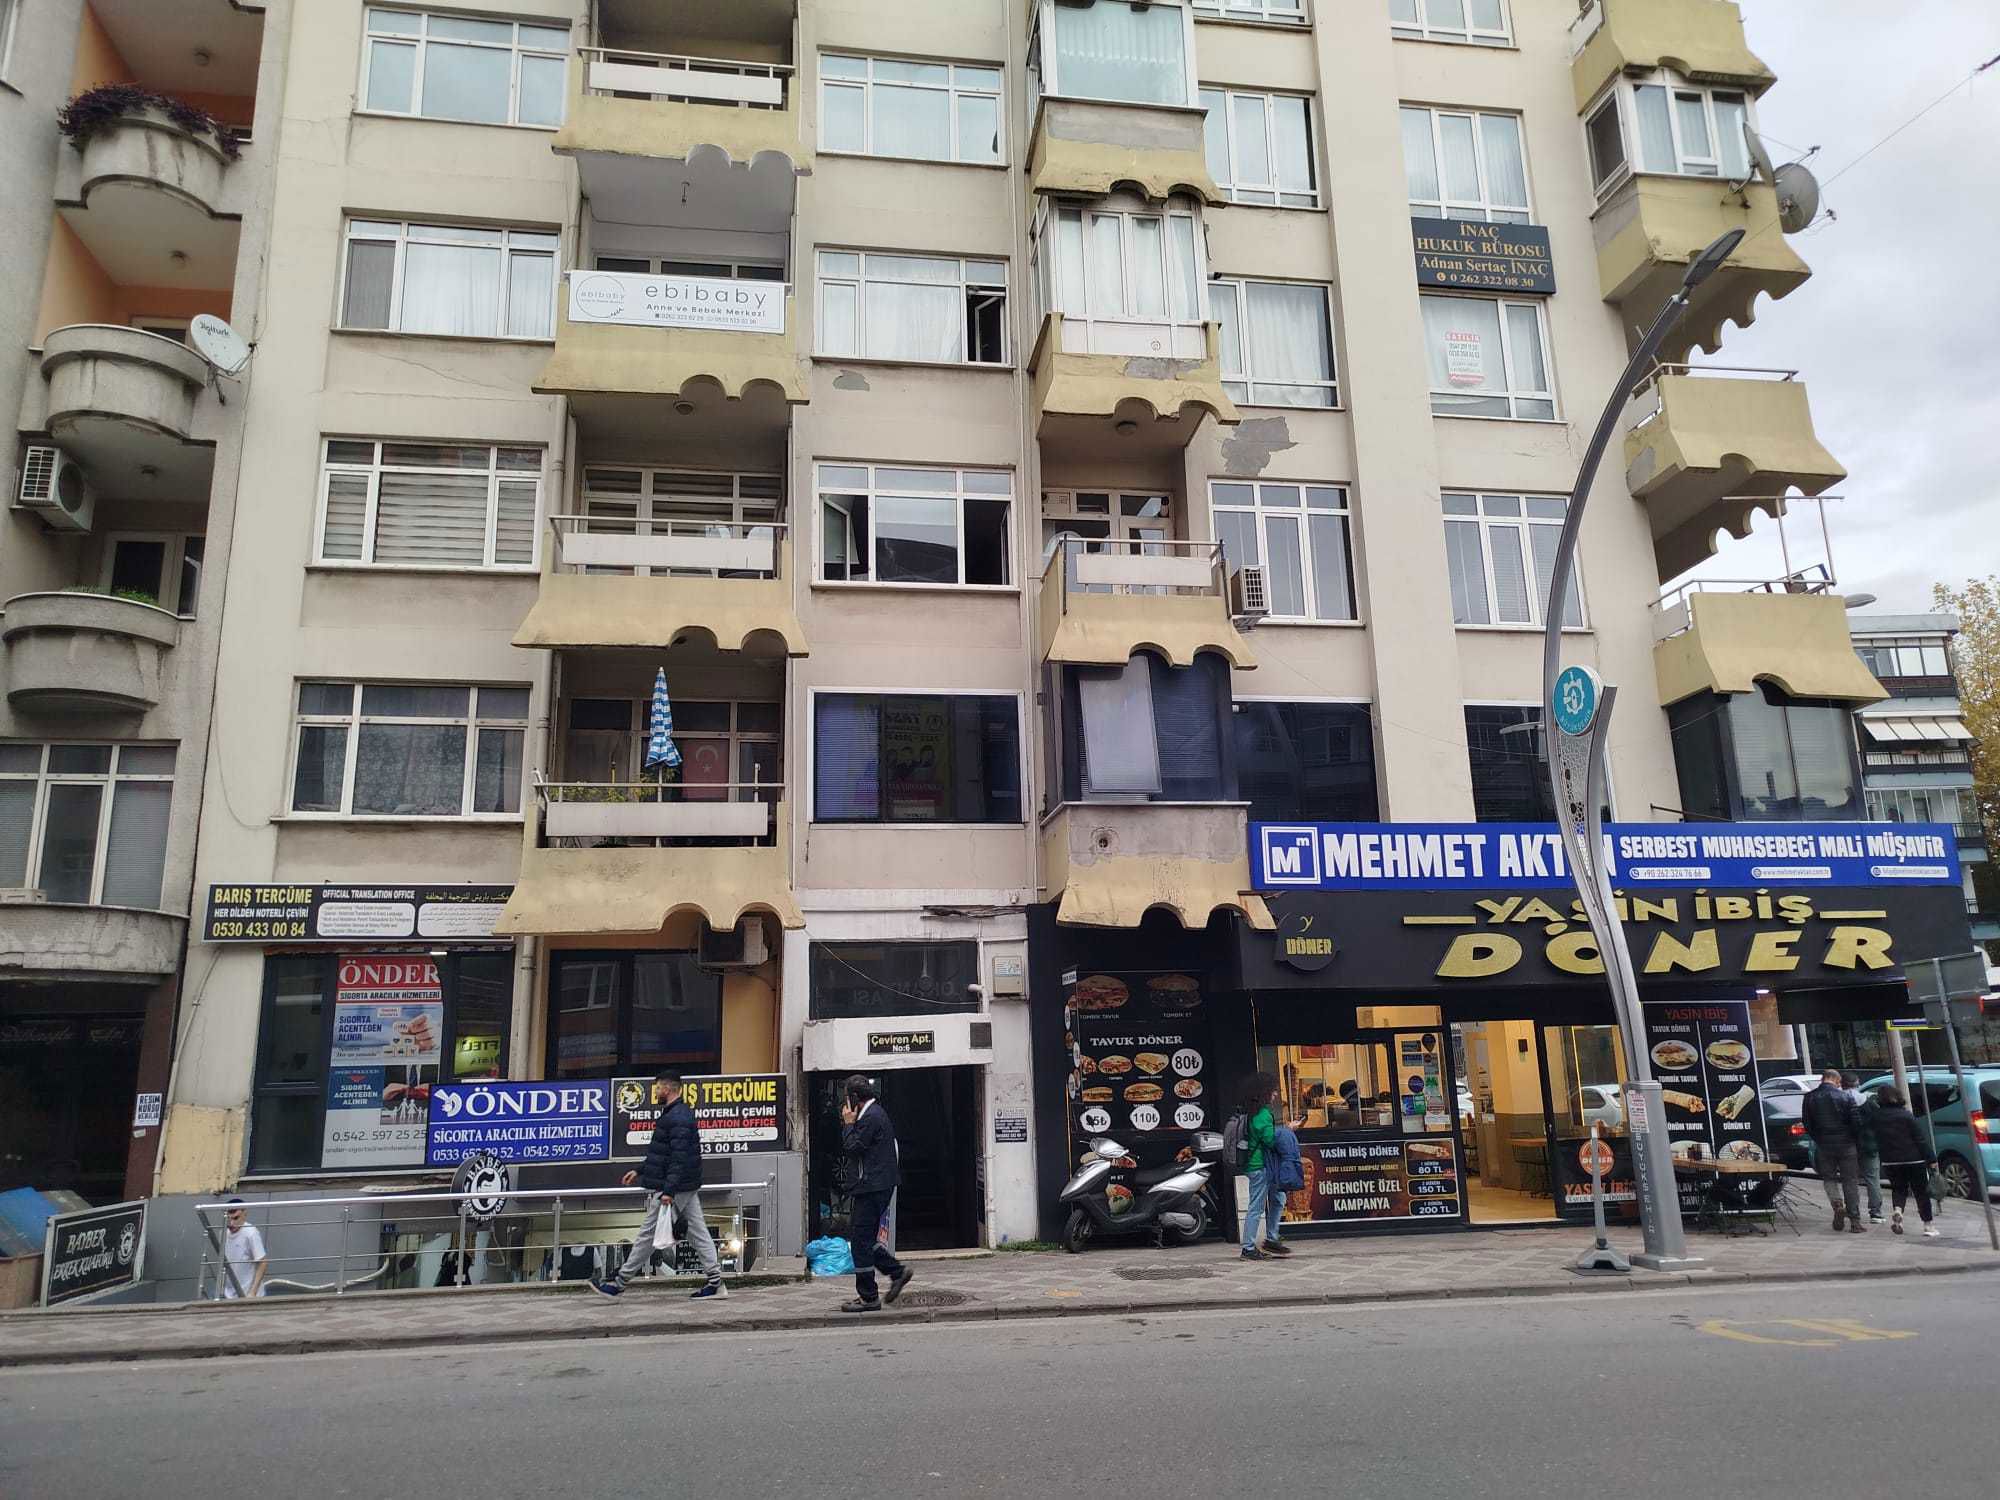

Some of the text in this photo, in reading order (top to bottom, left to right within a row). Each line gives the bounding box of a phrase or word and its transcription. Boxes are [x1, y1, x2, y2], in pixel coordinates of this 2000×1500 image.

[1460, 222, 1500, 239] İNAÇ
[1417, 237, 1546, 258] HUKUK BÜROSU
[1420, 256, 1549, 278] Adnan Sertaç İNAÇ
[1450, 274, 1457, 282] 0
[1460, 274, 1480, 285] 262
[1482, 275, 1502, 285] 322
[1521, 278, 1535, 287] 30
[645, 283, 767, 308] ebibaby
[646, 303, 673, 311] Anne
[691, 306, 722, 314] Bebek
[726, 309, 766, 317] Merkezi
[1322, 833, 1488, 879] MEHMET
[1619, 835, 1698, 859] SERBEST
[214, 886, 313, 907] BARIŞ TERCÜME
[322, 889, 415, 899] OFFICIAL TRANSLATION OFFICE
[214, 907, 230, 918] HER
[230, 907, 255, 918] DİLDEN
[255, 907, 285, 918] NOTERLİ
[286, 907, 309, 920] ÇEVİRİ
[1694, 887, 1816, 925] İBİŞ
[212, 922, 243, 937] 0530
[245, 922, 269, 937] 433
[271, 922, 288, 936] 00
[290, 922, 306, 936] 84
[1434, 921, 1896, 978] DÖNER
[339, 959, 441, 985] ÖNDER
[871, 1033, 932, 1048] Çeviren Apt.
[1089, 1032, 1184, 1047] TAVUK DÖNER
[702, 1078, 777, 1103] TERCÜME
[465, 1086, 606, 1117] ÖNDER
[629, 1111, 652, 1120] HER
[694, 1106, 740, 1118] NOTERLİ
[741, 1105, 777, 1118] ÇEVİRİ
[629, 1121, 657, 1131] OFFIC
[742, 1118, 776, 1127] OFFICE
[371, 1130, 393, 1141] 597
[395, 1130, 410, 1140] 25
[433, 1121, 603, 1144] SİGORTA ARACILIK HİZMETLERİ
[433, 1149, 460, 1161] 0533
[500, 1147, 513, 1158] 52
[523, 1146, 550, 1158] 0542
[551, 1145, 571, 1156] 597
[573, 1144, 587, 1155] 25
[588, 1143, 602, 1154] 25
[715, 1142, 730, 1153] 00
[733, 1142, 749, 1152] 84
[1319, 1144, 1400, 1159] YASİN İBİŞ DÖNER
[1418, 1166, 1431, 1174] 80
[1318, 1177, 1403, 1196] ÖĞRENCİYE ÖZEL
[1417, 1185, 1447, 1194] 150 TL
[1333, 1197, 1391, 1212] KAMPANYA
[1418, 1205, 1451, 1214] 200 TL
